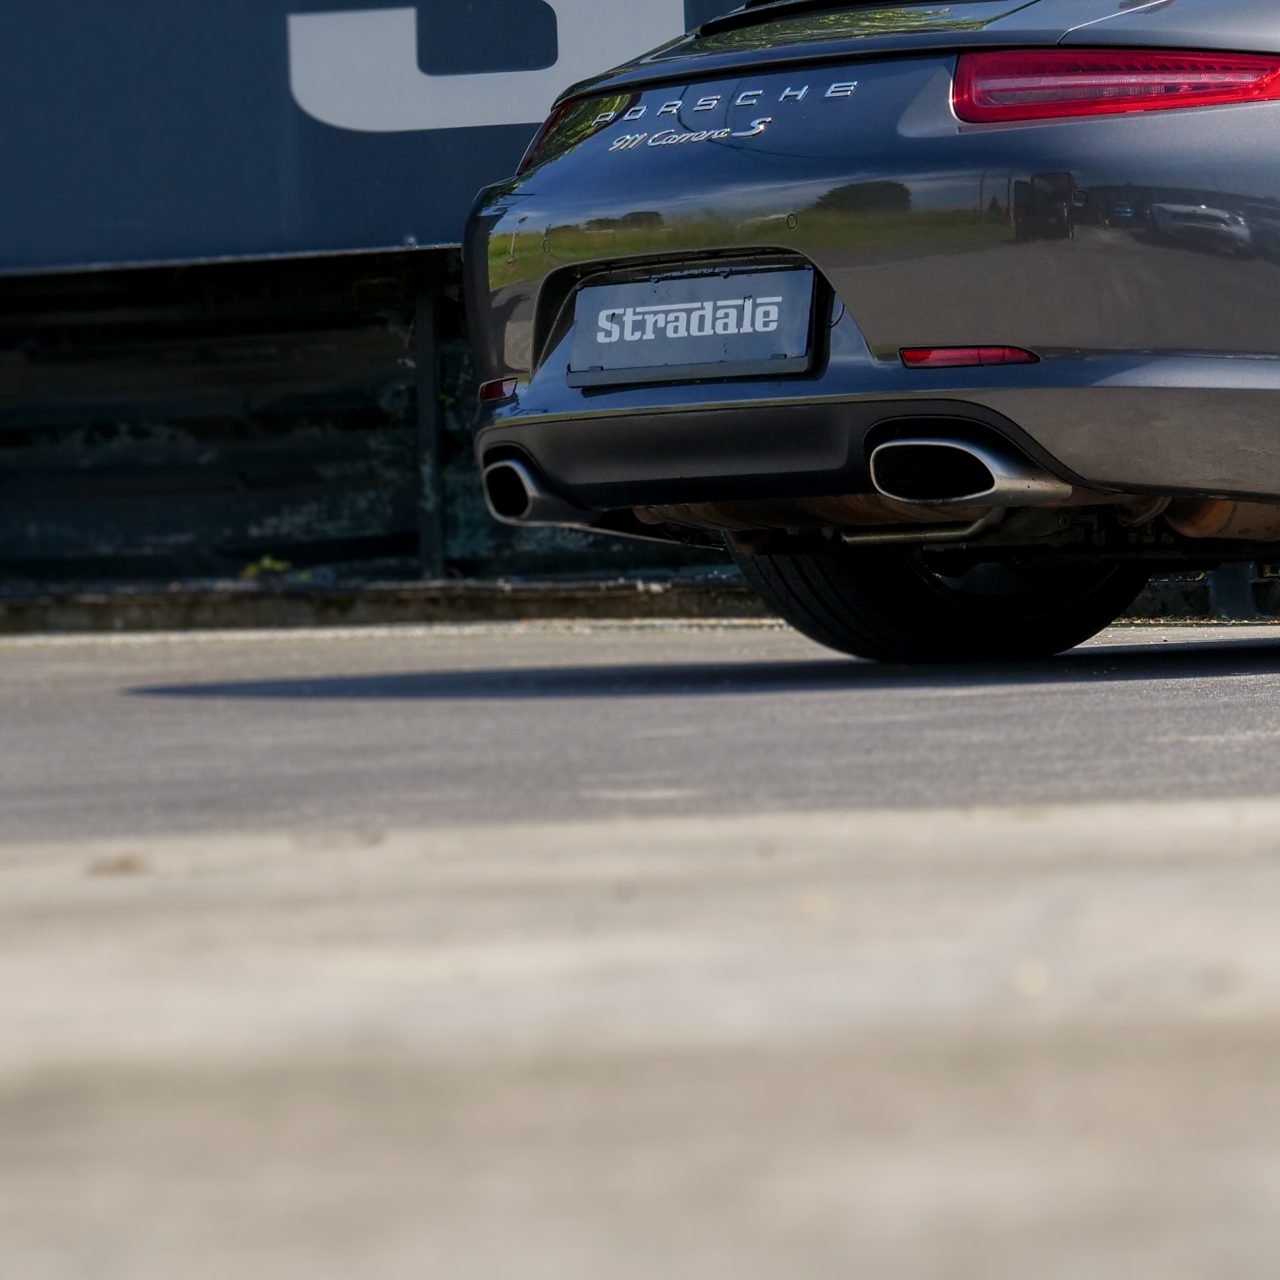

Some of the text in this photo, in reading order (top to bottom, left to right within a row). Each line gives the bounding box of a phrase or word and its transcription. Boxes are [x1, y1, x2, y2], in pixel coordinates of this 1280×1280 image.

[590, 81, 858, 126] PORSCHE
[609, 117, 772, 152] 911 Carrera S
[596, 296, 782, 343] Stradale
